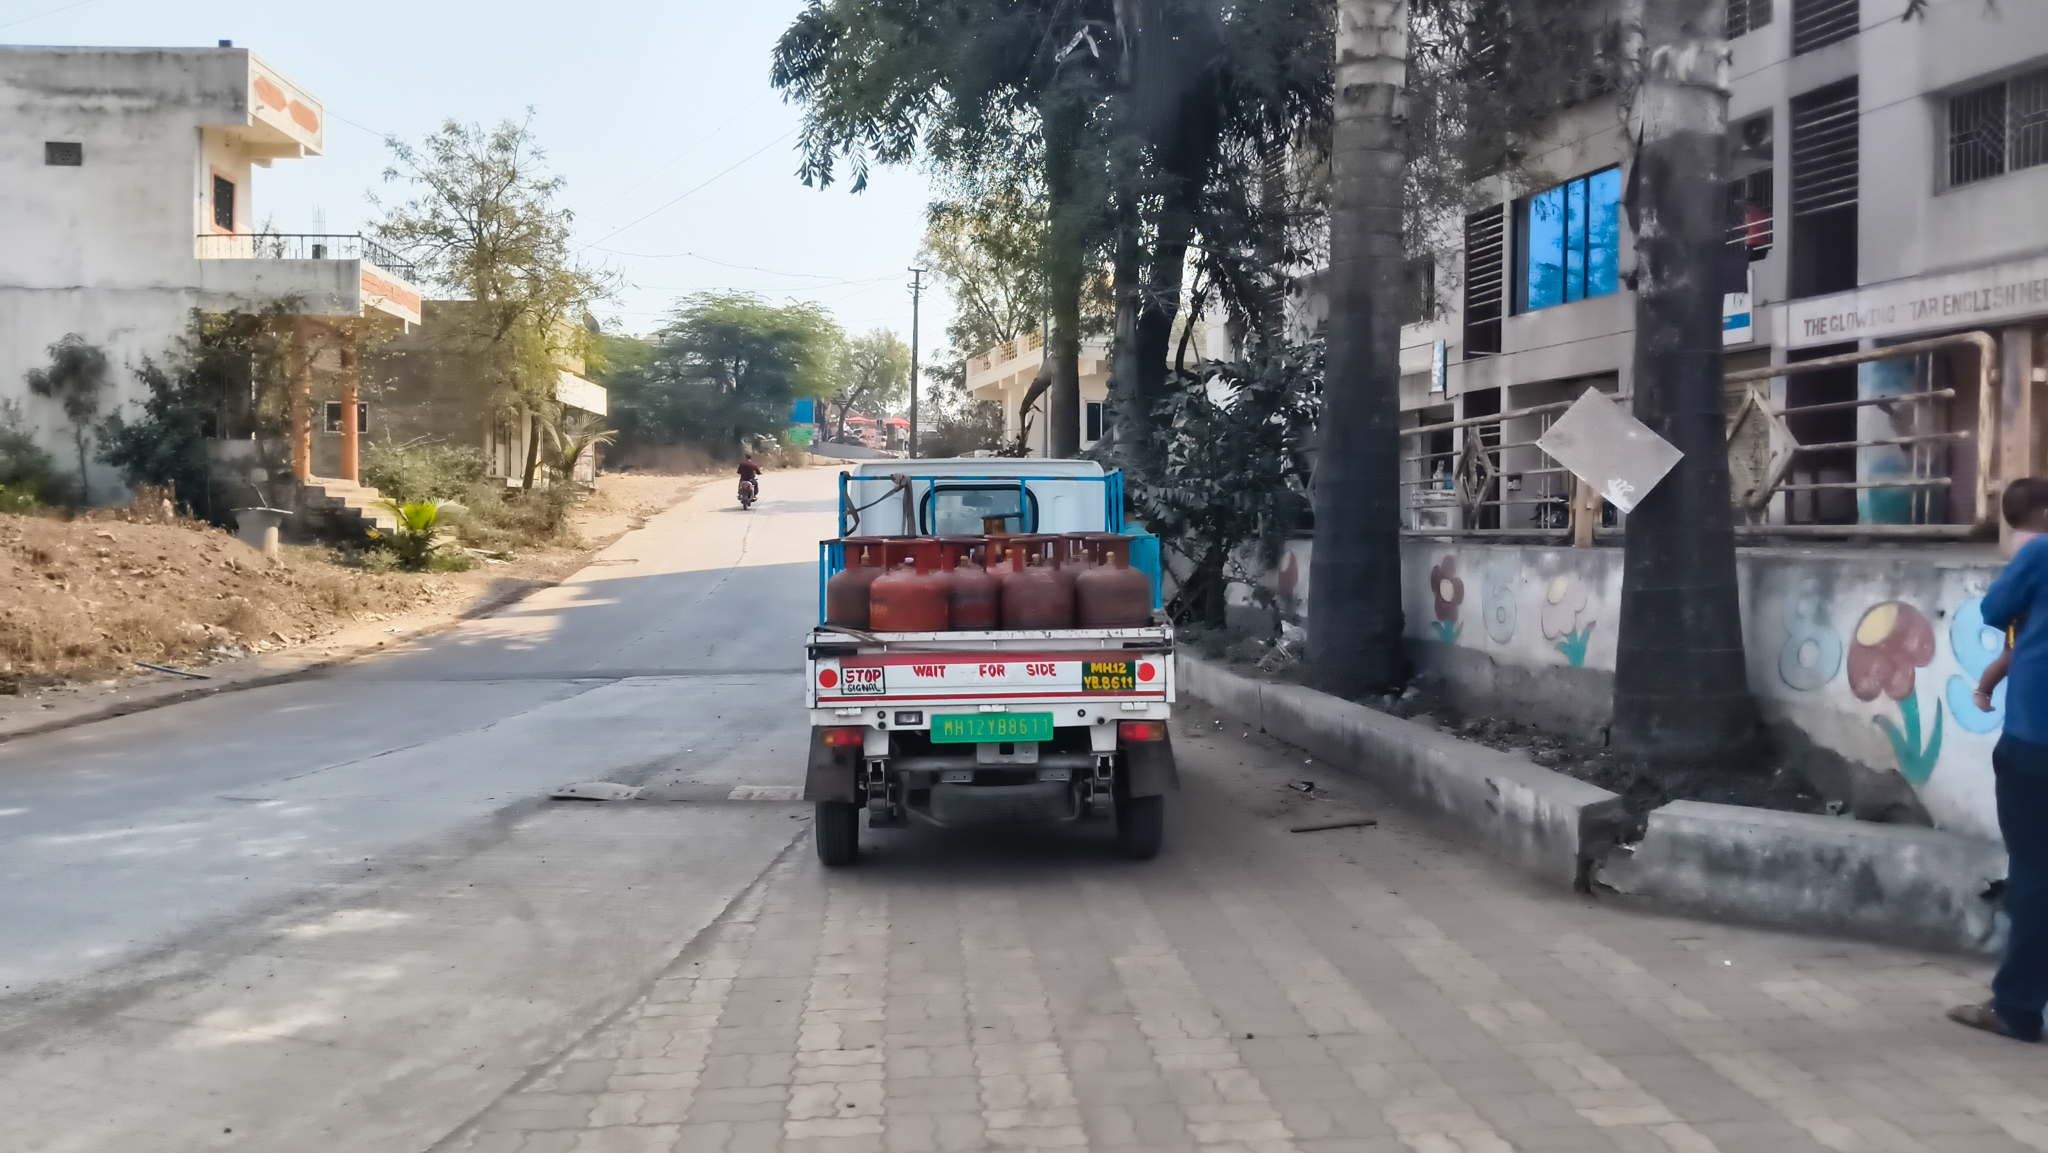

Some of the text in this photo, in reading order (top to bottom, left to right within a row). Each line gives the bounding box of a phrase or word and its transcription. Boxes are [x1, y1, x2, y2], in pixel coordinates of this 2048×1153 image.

[1803, 317, 1828, 337] THE
[1901, 297, 1938, 321] TAR
[1778, 579, 1843, 691] 8
[845, 669, 881, 684] STOP
[913, 665, 946, 678] WAIT
[979, 664, 1006, 677] FOR
[1026, 663, 1057, 676] SIDE
[847, 683, 881, 692] SIGNAL
[944, 718, 1049, 736] MH12YB8611
